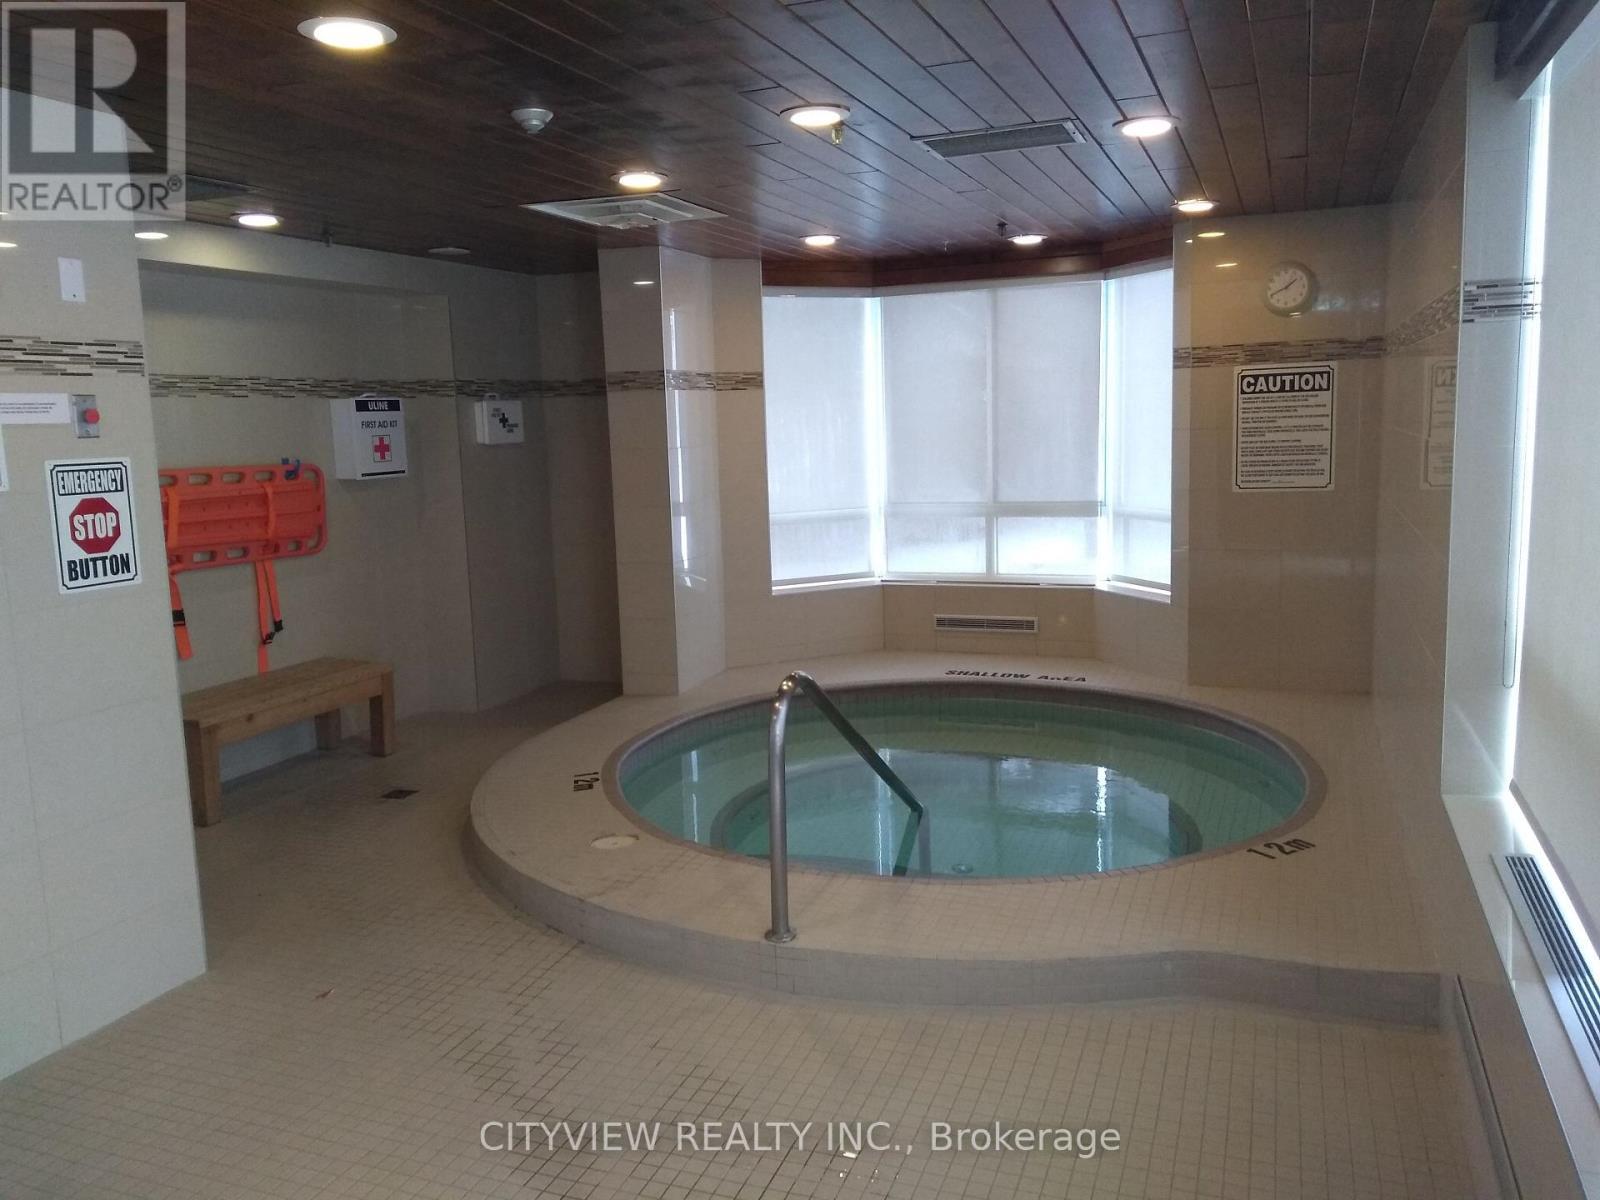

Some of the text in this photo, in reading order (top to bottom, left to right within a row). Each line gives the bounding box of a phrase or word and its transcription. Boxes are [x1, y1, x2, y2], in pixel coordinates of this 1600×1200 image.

[1242, 373, 1329, 393] CAUTION
[368, 400, 389, 410] ULINE
[361, 419, 398, 429] FIRST AID KIT
[58, 469, 123, 495] EMERGENCY
[73, 512, 117, 541] STOP
[66, 553, 131, 582] BUTTON
[945, 669, 1031, 679] SHALLOW
